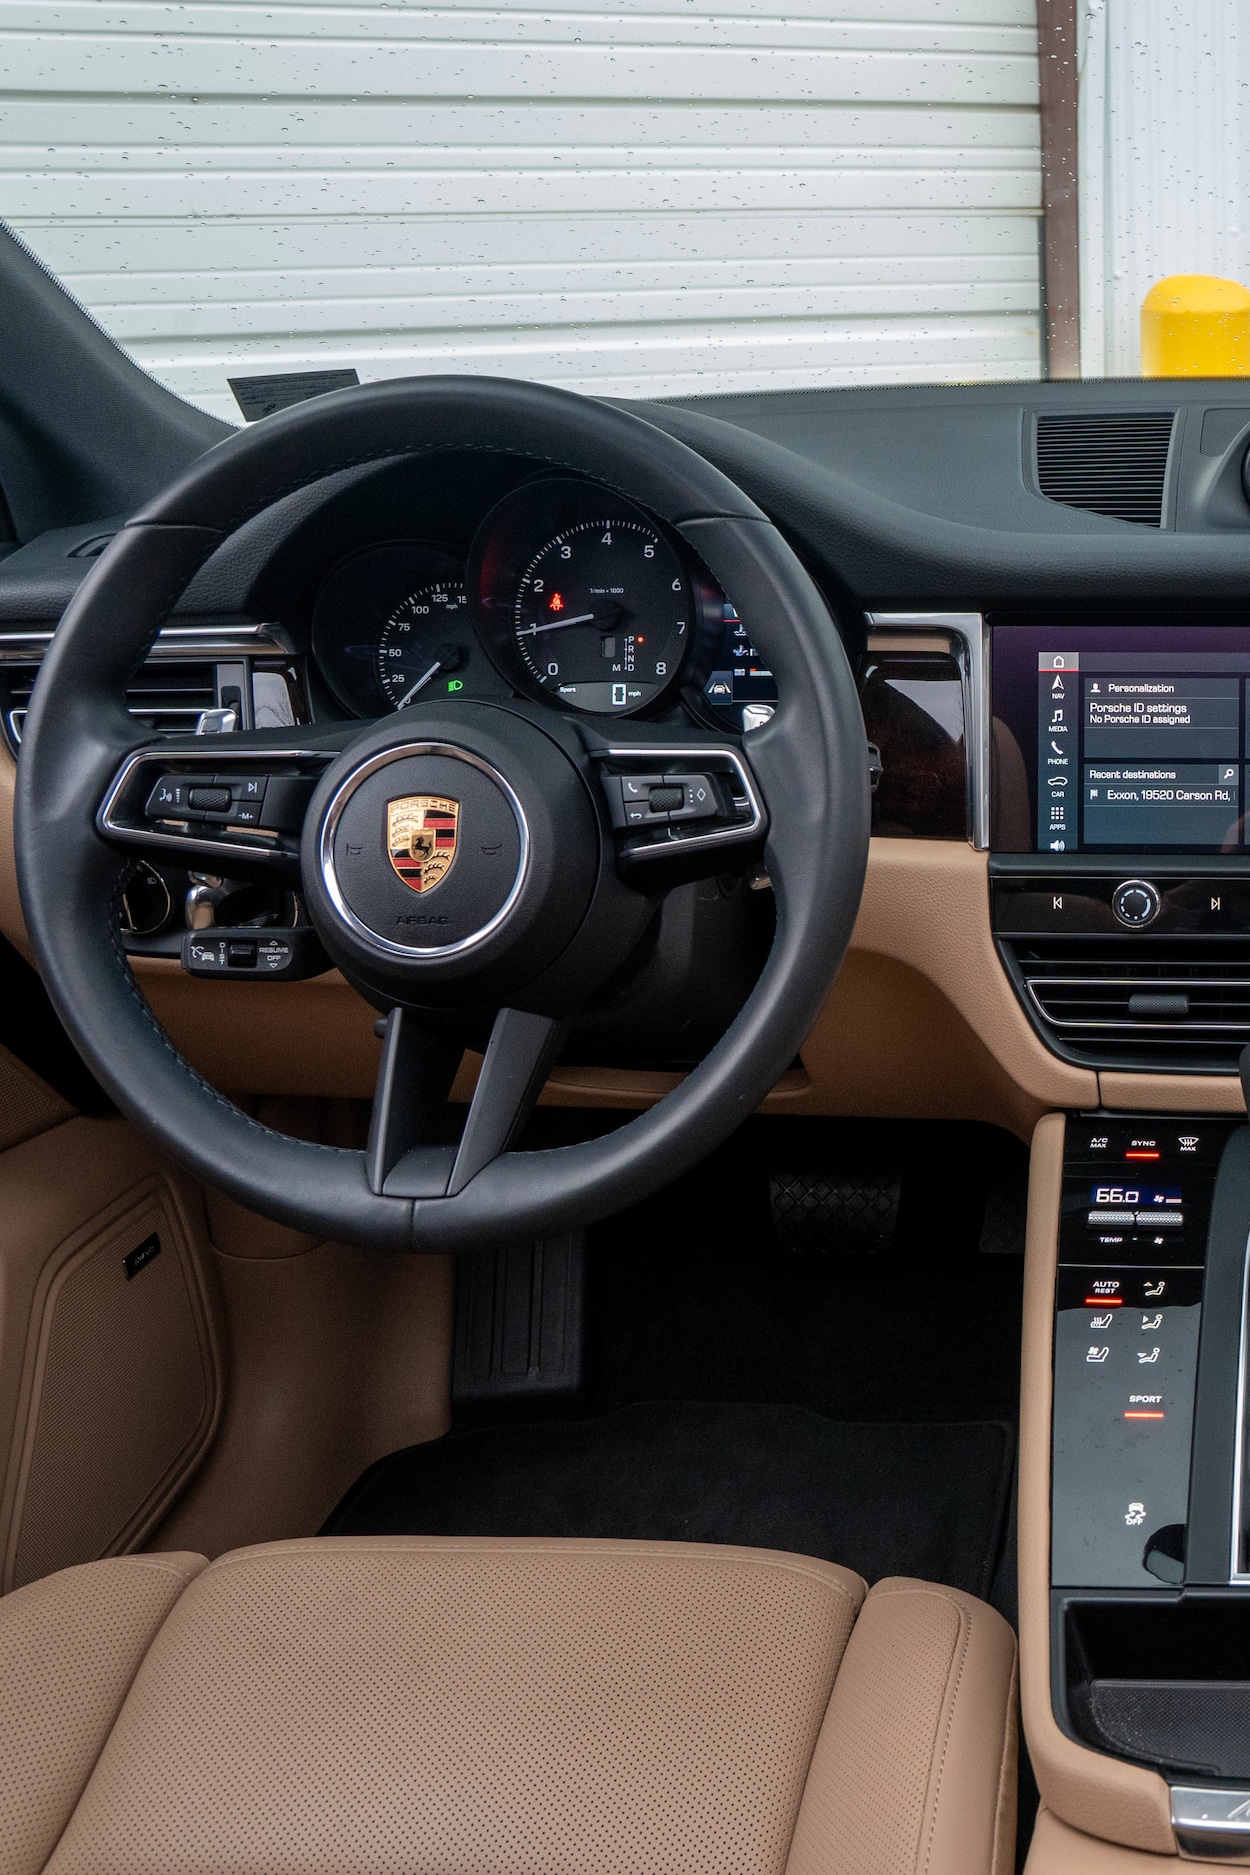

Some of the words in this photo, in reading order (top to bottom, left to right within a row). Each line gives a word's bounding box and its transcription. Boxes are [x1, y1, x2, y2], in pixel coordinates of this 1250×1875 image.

[601, 532, 612, 546] 4
[560, 546, 572, 559] 3
[643, 545, 655, 558] 5
[533, 579, 544, 592] 2
[671, 578, 682, 591] 6
[431, 594, 449, 603] 125
[411, 605, 430, 615] 100
[398, 623, 411, 631] 75
[676, 621, 687, 635] 7
[388, 648, 402, 657] 50
[628, 645, 635, 653] R
[547, 662, 559, 676] 0
[655, 661, 667, 675] 8
[391, 674, 405, 683] 25
[1108, 683, 1175, 693] Personalization
[612, 683, 627, 705] 0
[1089, 703, 1132, 713] Porsche
[1134, 703, 1145, 713] ID
[1146, 703, 1188, 715] settings
[1089, 715, 1102, 723] No
[1104, 715, 1140, 724] Porsche
[1141, 715, 1151, 723] ID
[1152, 715, 1191, 726] assigned
[1089, 770, 1121, 779] Recent
[1122, 770, 1177, 779] destinations
[1107, 790, 1139, 801] Exxon,
[1141, 790, 1174, 801] 19520
[1175, 790, 1213, 801] Carson
[1214, 789, 1231, 802] Rd,
[389, 799, 457, 813] PORSCHE
[1049, 823, 1066, 831] APPS
[395, 915, 450, 926] AIRBAG
[258, 946, 289, 954] RESUME
[1095, 1188, 1140, 1203] 66.0
[1129, 1395, 1162, 1403] SPORT
